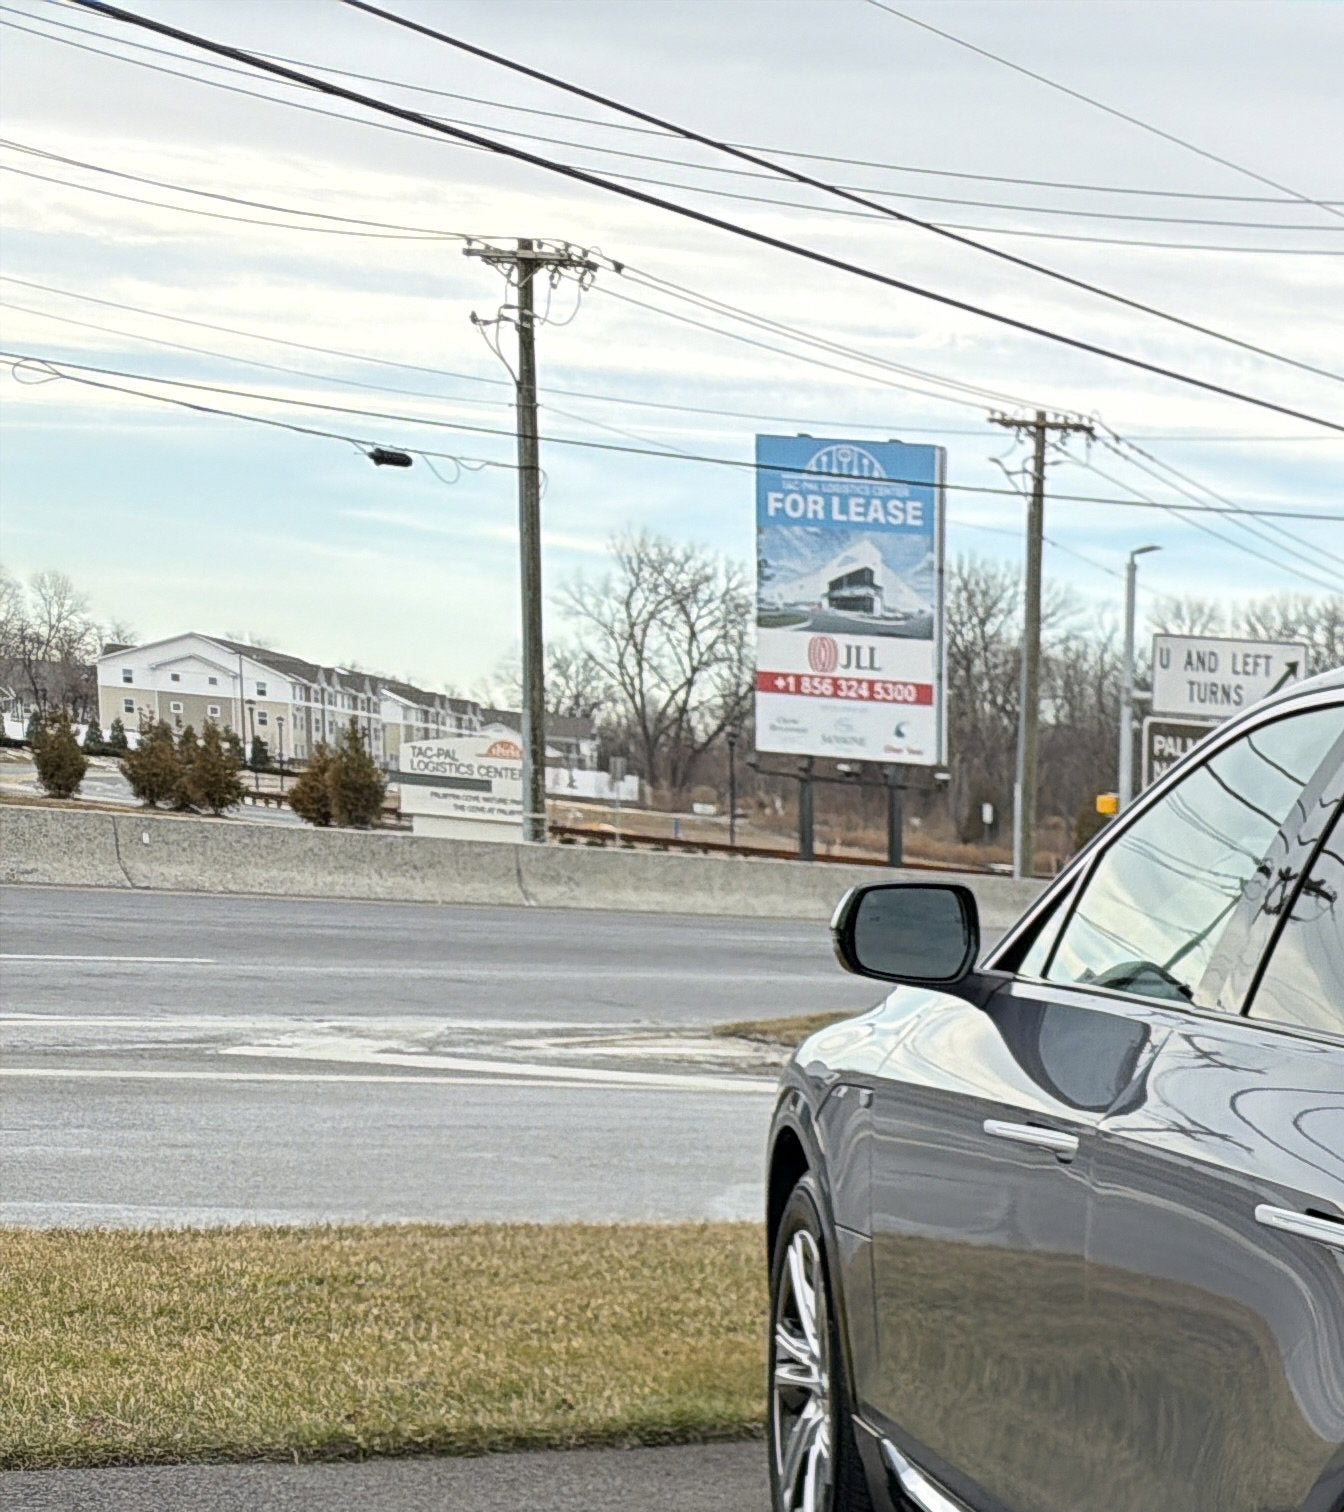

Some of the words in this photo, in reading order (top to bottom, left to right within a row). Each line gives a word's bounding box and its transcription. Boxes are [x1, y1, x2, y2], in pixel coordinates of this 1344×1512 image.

[767, 491, 825, 519] FOR
[831, 495, 923, 526] LEASE
[840, 643, 882, 671] JLL
[1159, 647, 1170, 669] U
[1184, 650, 1219, 674] AND
[1231, 652, 1273, 677] LEFT
[774, 675, 796, 692] +1
[800, 676, 833, 695] 856
[837, 679, 869, 699] 324
[873, 683, 917, 702] 5300
[1187, 680, 1244, 706] TURNS
[410, 745, 459, 762] TAC-PAL
[410, 759, 475, 777] LOGISTICS
[477, 764, 523, 781] CENTE
